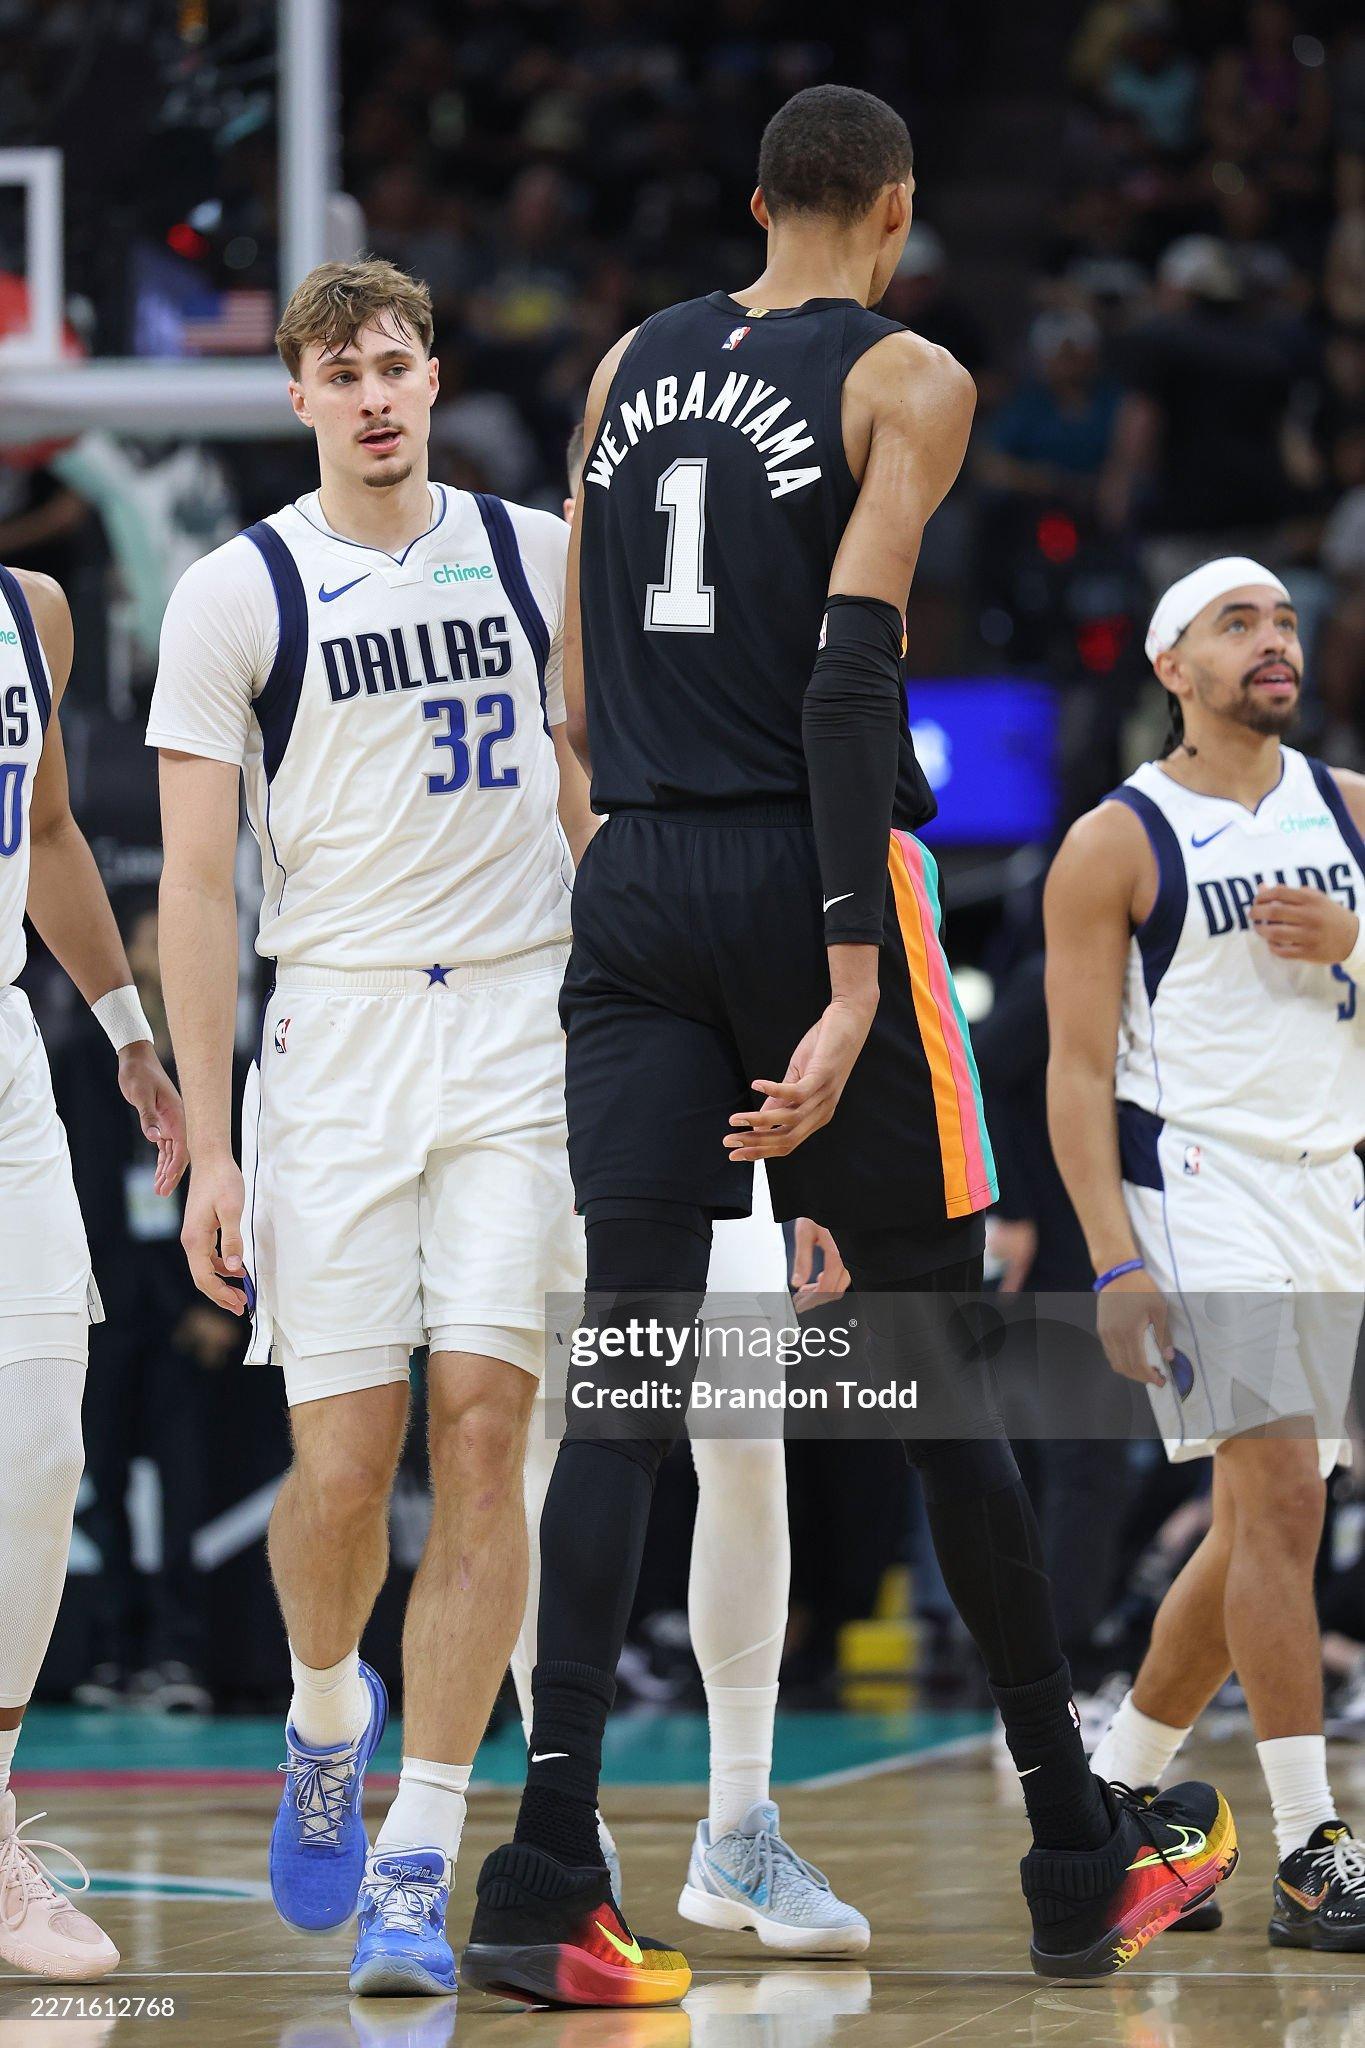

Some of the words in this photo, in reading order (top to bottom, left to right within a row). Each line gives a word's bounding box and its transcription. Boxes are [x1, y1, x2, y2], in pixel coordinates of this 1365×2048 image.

[586, 371, 822, 499] WEMBANYAMA
[433, 563, 494, 584] chime
[644, 458, 715, 634] 1
[320, 614, 514, 704] DALLAS
[421, 691, 521, 801] 32
